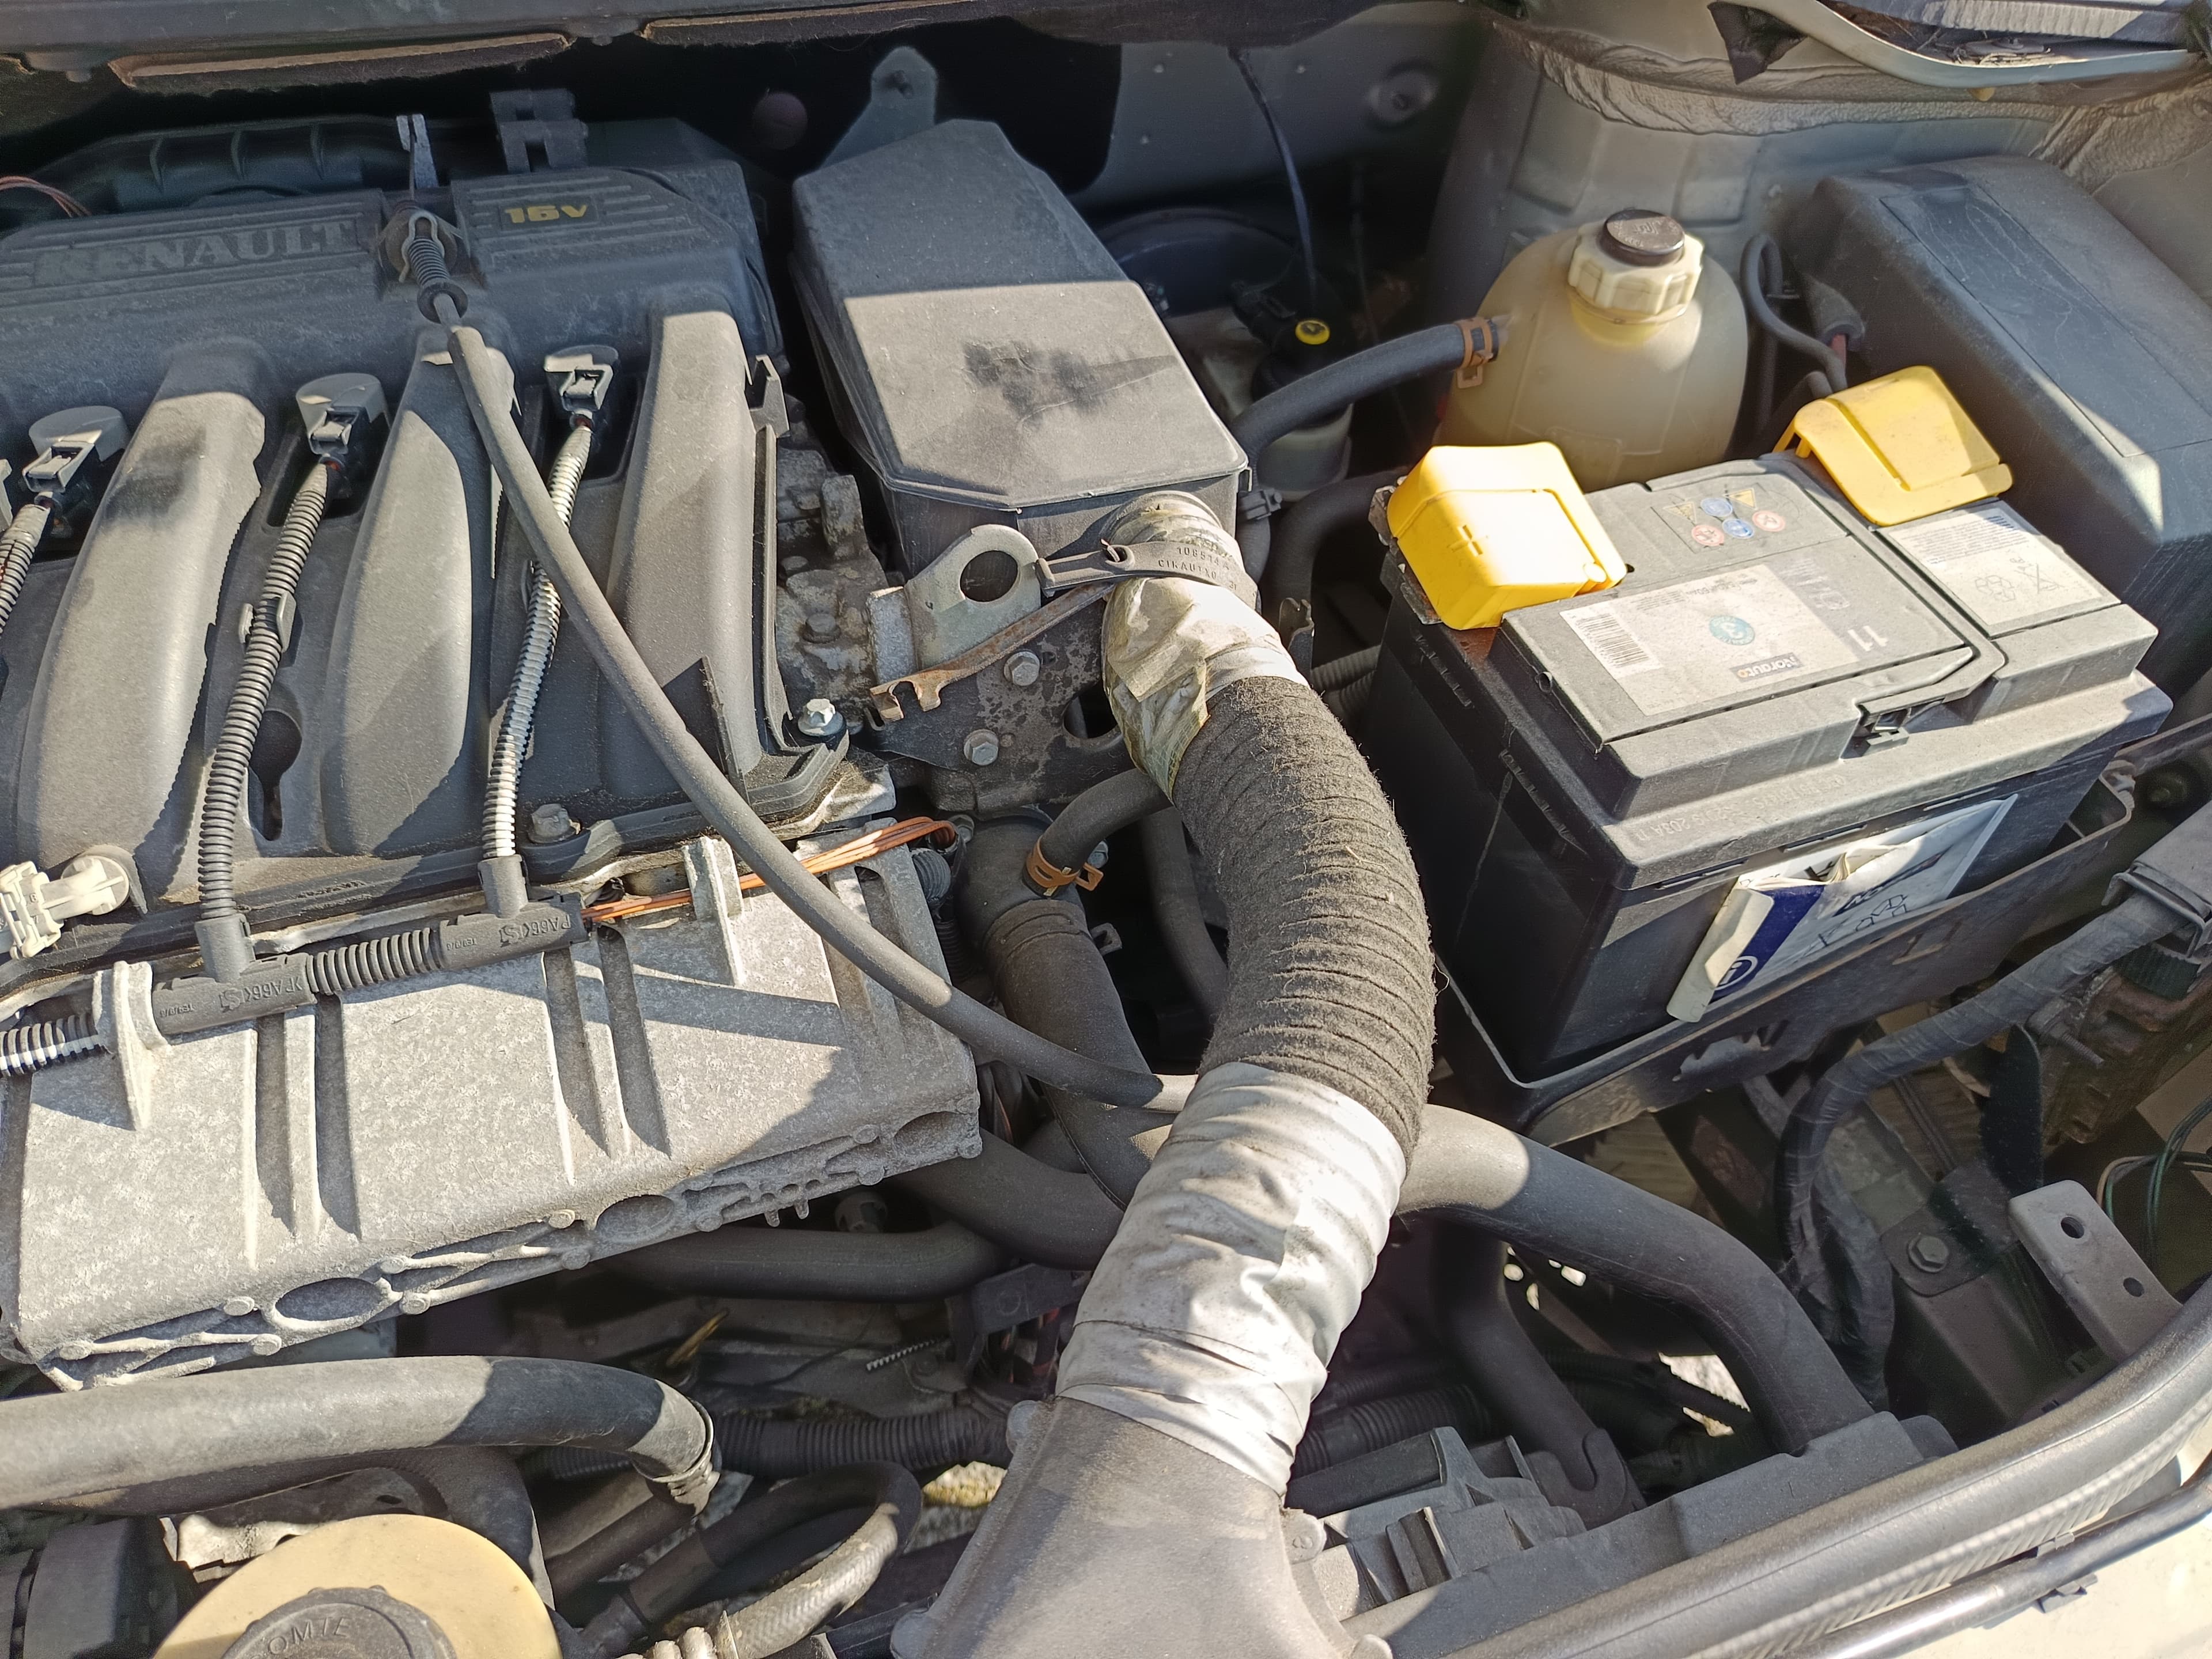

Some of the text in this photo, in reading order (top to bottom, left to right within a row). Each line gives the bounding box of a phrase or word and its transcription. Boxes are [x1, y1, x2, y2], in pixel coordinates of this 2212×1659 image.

[35, 221, 355, 286] RENAULT
[1847, 625, 1889, 652] 11
[1736, 656, 1797, 679] Norauto
